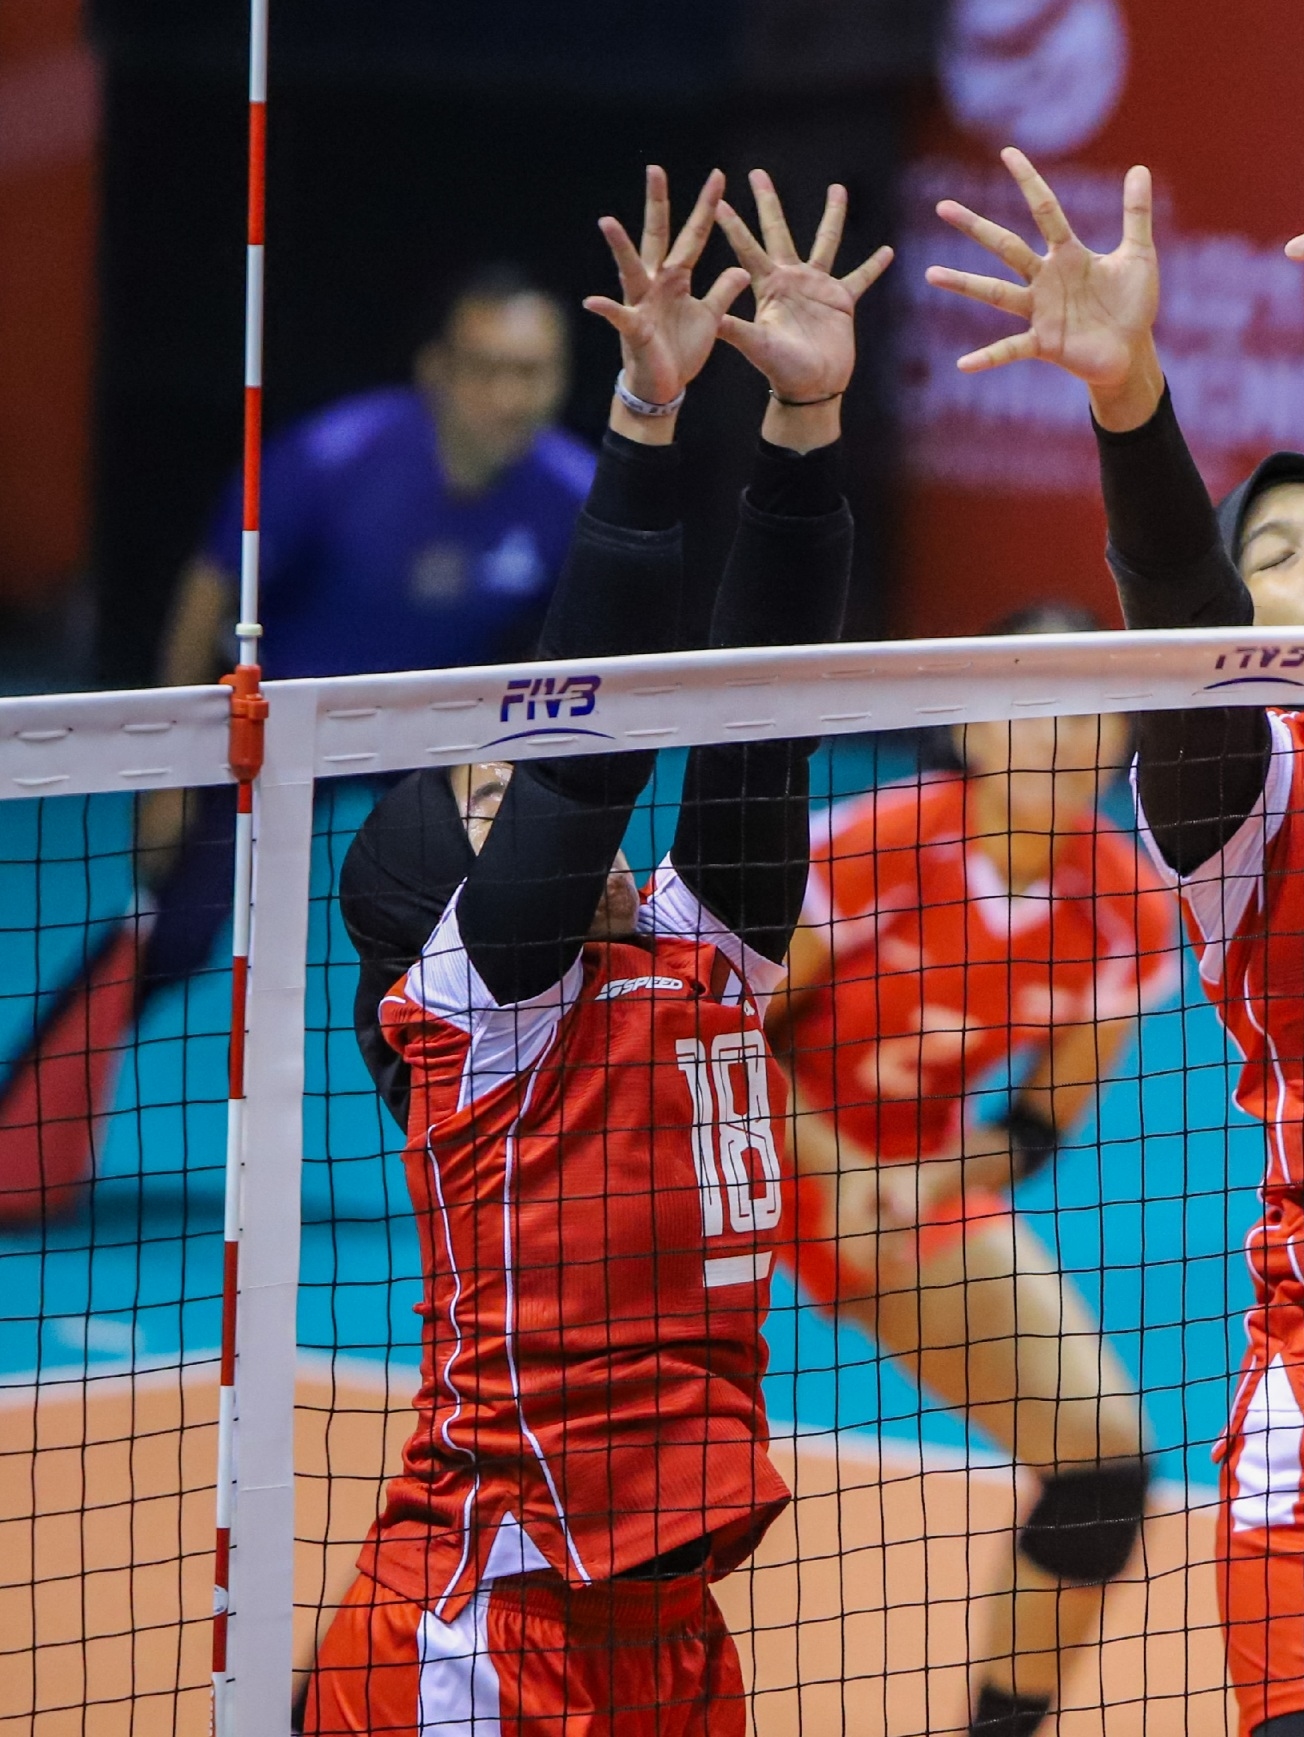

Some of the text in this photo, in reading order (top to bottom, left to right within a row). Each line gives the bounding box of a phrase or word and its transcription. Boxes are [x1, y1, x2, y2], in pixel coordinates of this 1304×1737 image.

[499, 675, 602, 723] FIVB
[618, 975, 683, 997] SPEED
[675, 1029, 782, 1237] 18
